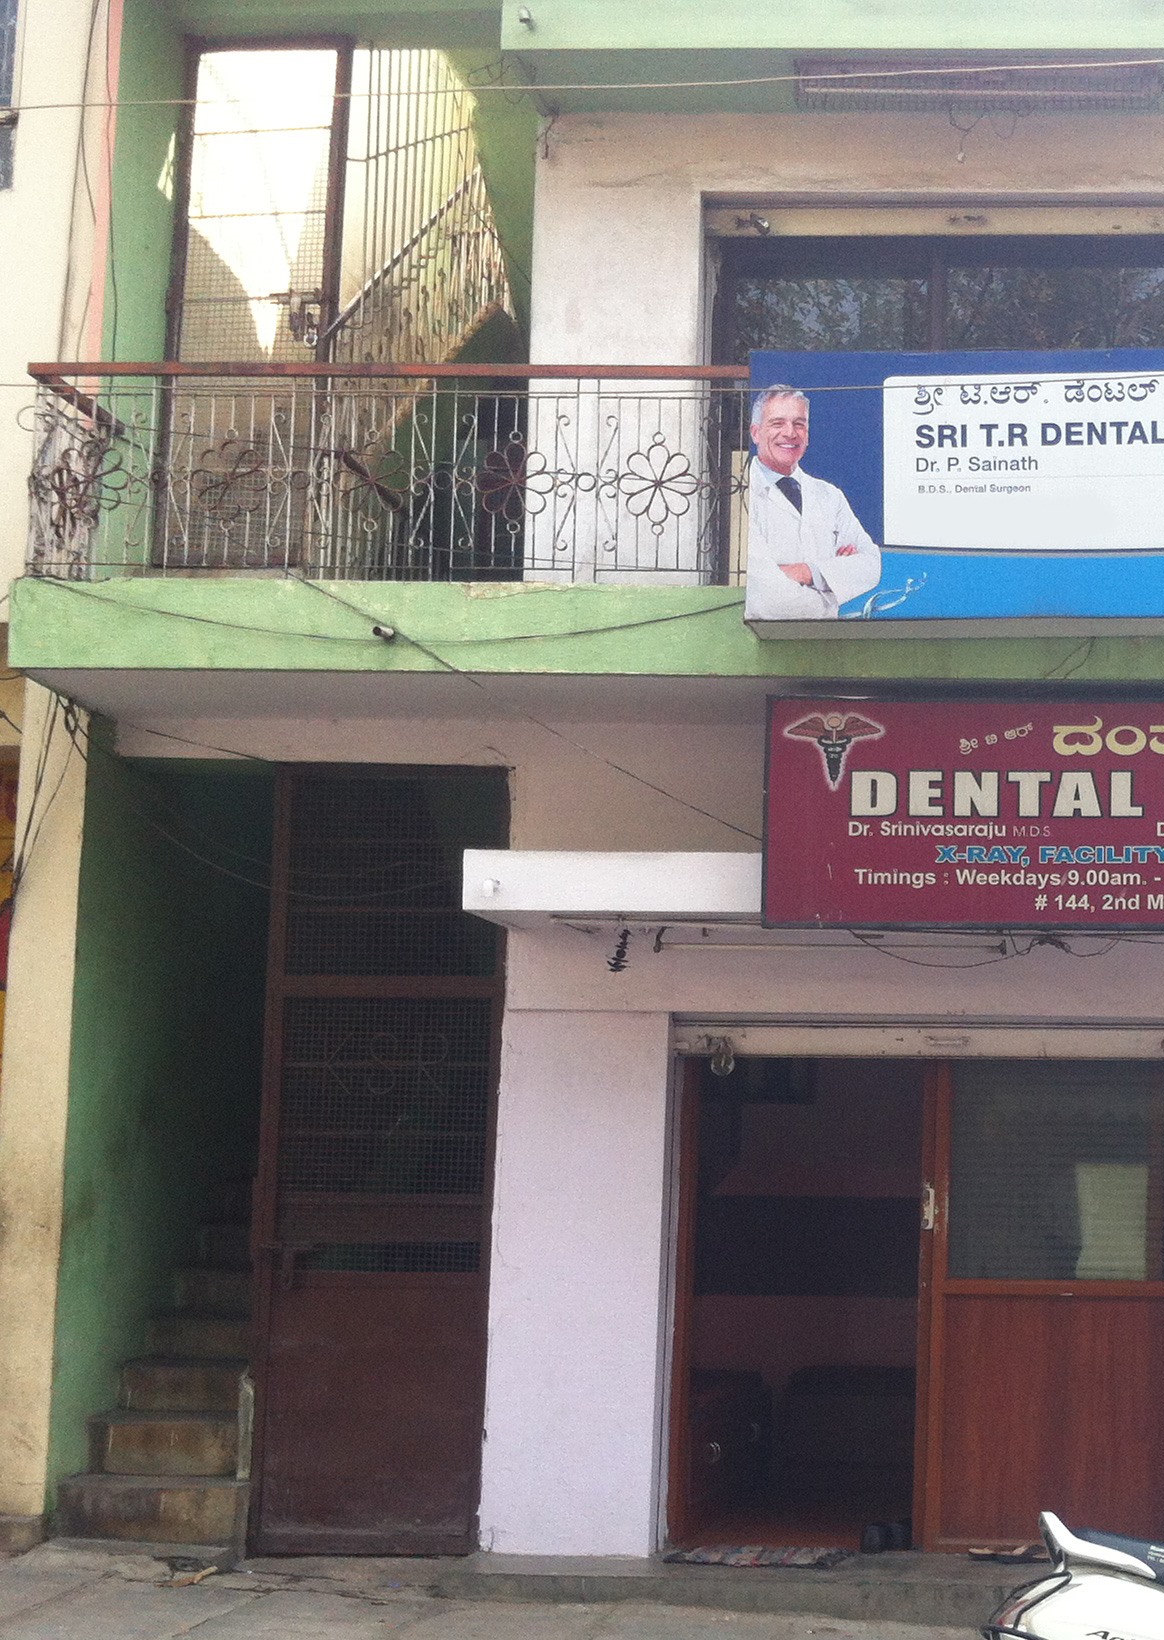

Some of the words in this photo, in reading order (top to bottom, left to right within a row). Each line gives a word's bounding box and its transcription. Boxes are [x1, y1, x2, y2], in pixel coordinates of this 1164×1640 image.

[1064, 378, 1159, 404] ಡೆಂಟಲ್
[916, 424, 967, 448] SRI
[980, 423, 1027, 447] T.R
[916, 458, 940, 472] Dr.
[947, 458, 961, 472] P.
[969, 456, 1038, 471] Sainath
[955, 484, 986, 493] Dental
[989, 483, 1031, 494] Surgeon
[850, 771, 1144, 817] DENTAL
[848, 822, 873, 836] Dr.
[880, 821, 1006, 839] Srinivasaraju
[936, 845, 1030, 867] X-RAY,
[855, 868, 936, 888] Timings
[957, 869, 1061, 889] Weekdays
[1054, 894, 1095, 912] 144,
[1102, 894, 1139, 910] 2nd
